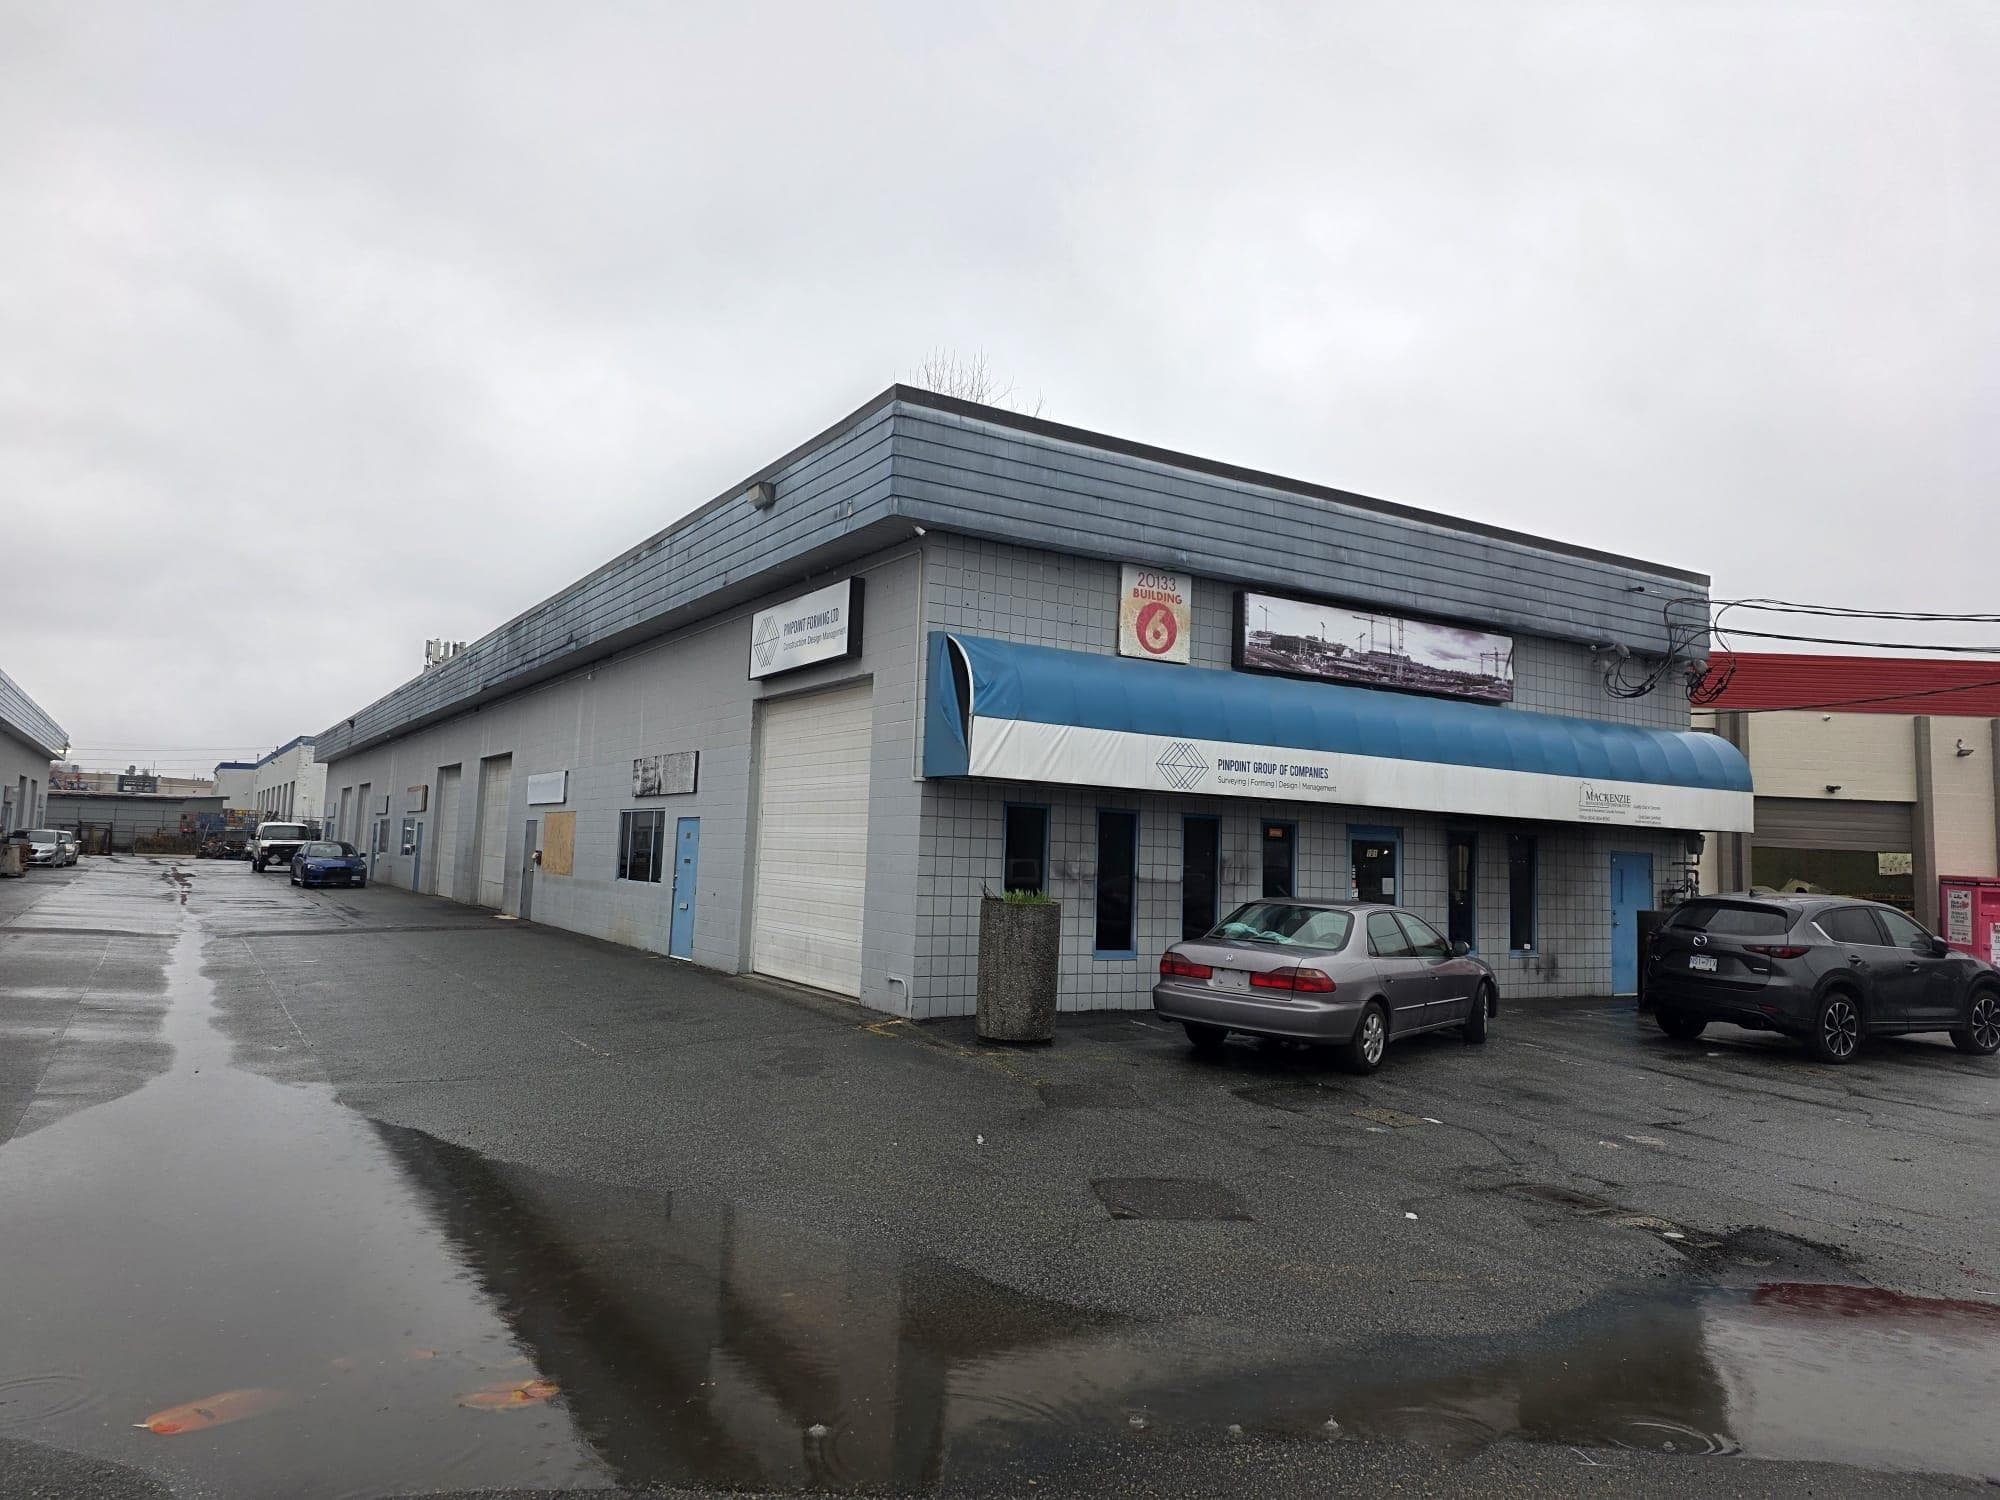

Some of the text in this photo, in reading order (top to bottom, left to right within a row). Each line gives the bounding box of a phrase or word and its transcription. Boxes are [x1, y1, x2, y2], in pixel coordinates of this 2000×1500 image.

[1137, 571, 1176, 592] 20133
[1132, 587, 1183, 605] BUILDING
[830, 607, 840, 623] LTD
[1145, 608, 1169, 650] 6
[1217, 758, 1329, 779] PINPOINT GROUP OF COMPANIES
[1217, 776, 1337, 793] Surveying Forming Design Management
